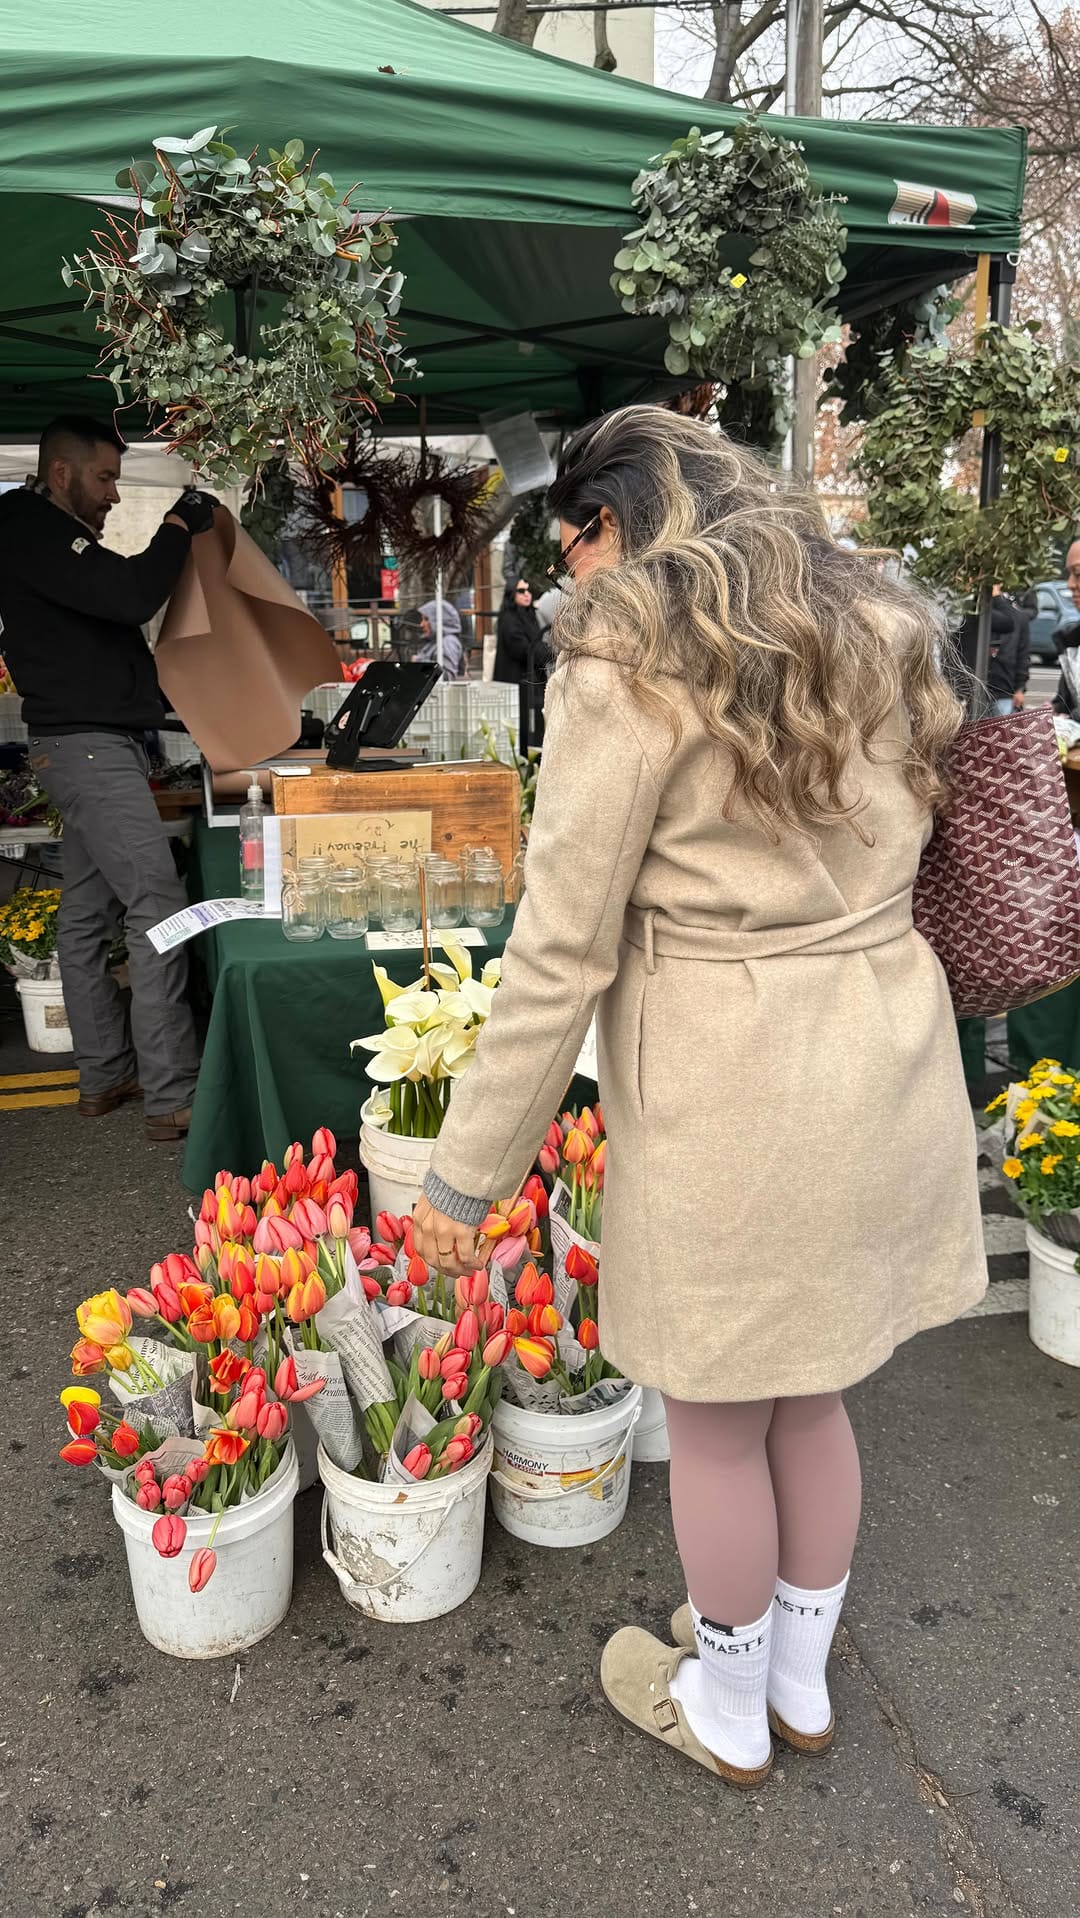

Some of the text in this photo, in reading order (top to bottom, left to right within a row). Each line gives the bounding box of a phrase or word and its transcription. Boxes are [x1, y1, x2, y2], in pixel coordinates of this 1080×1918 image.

[503, 1448, 549, 1470] HARMONY
[775, 1594, 825, 1617] ASTE
[693, 1625, 766, 1655] AMASTE
